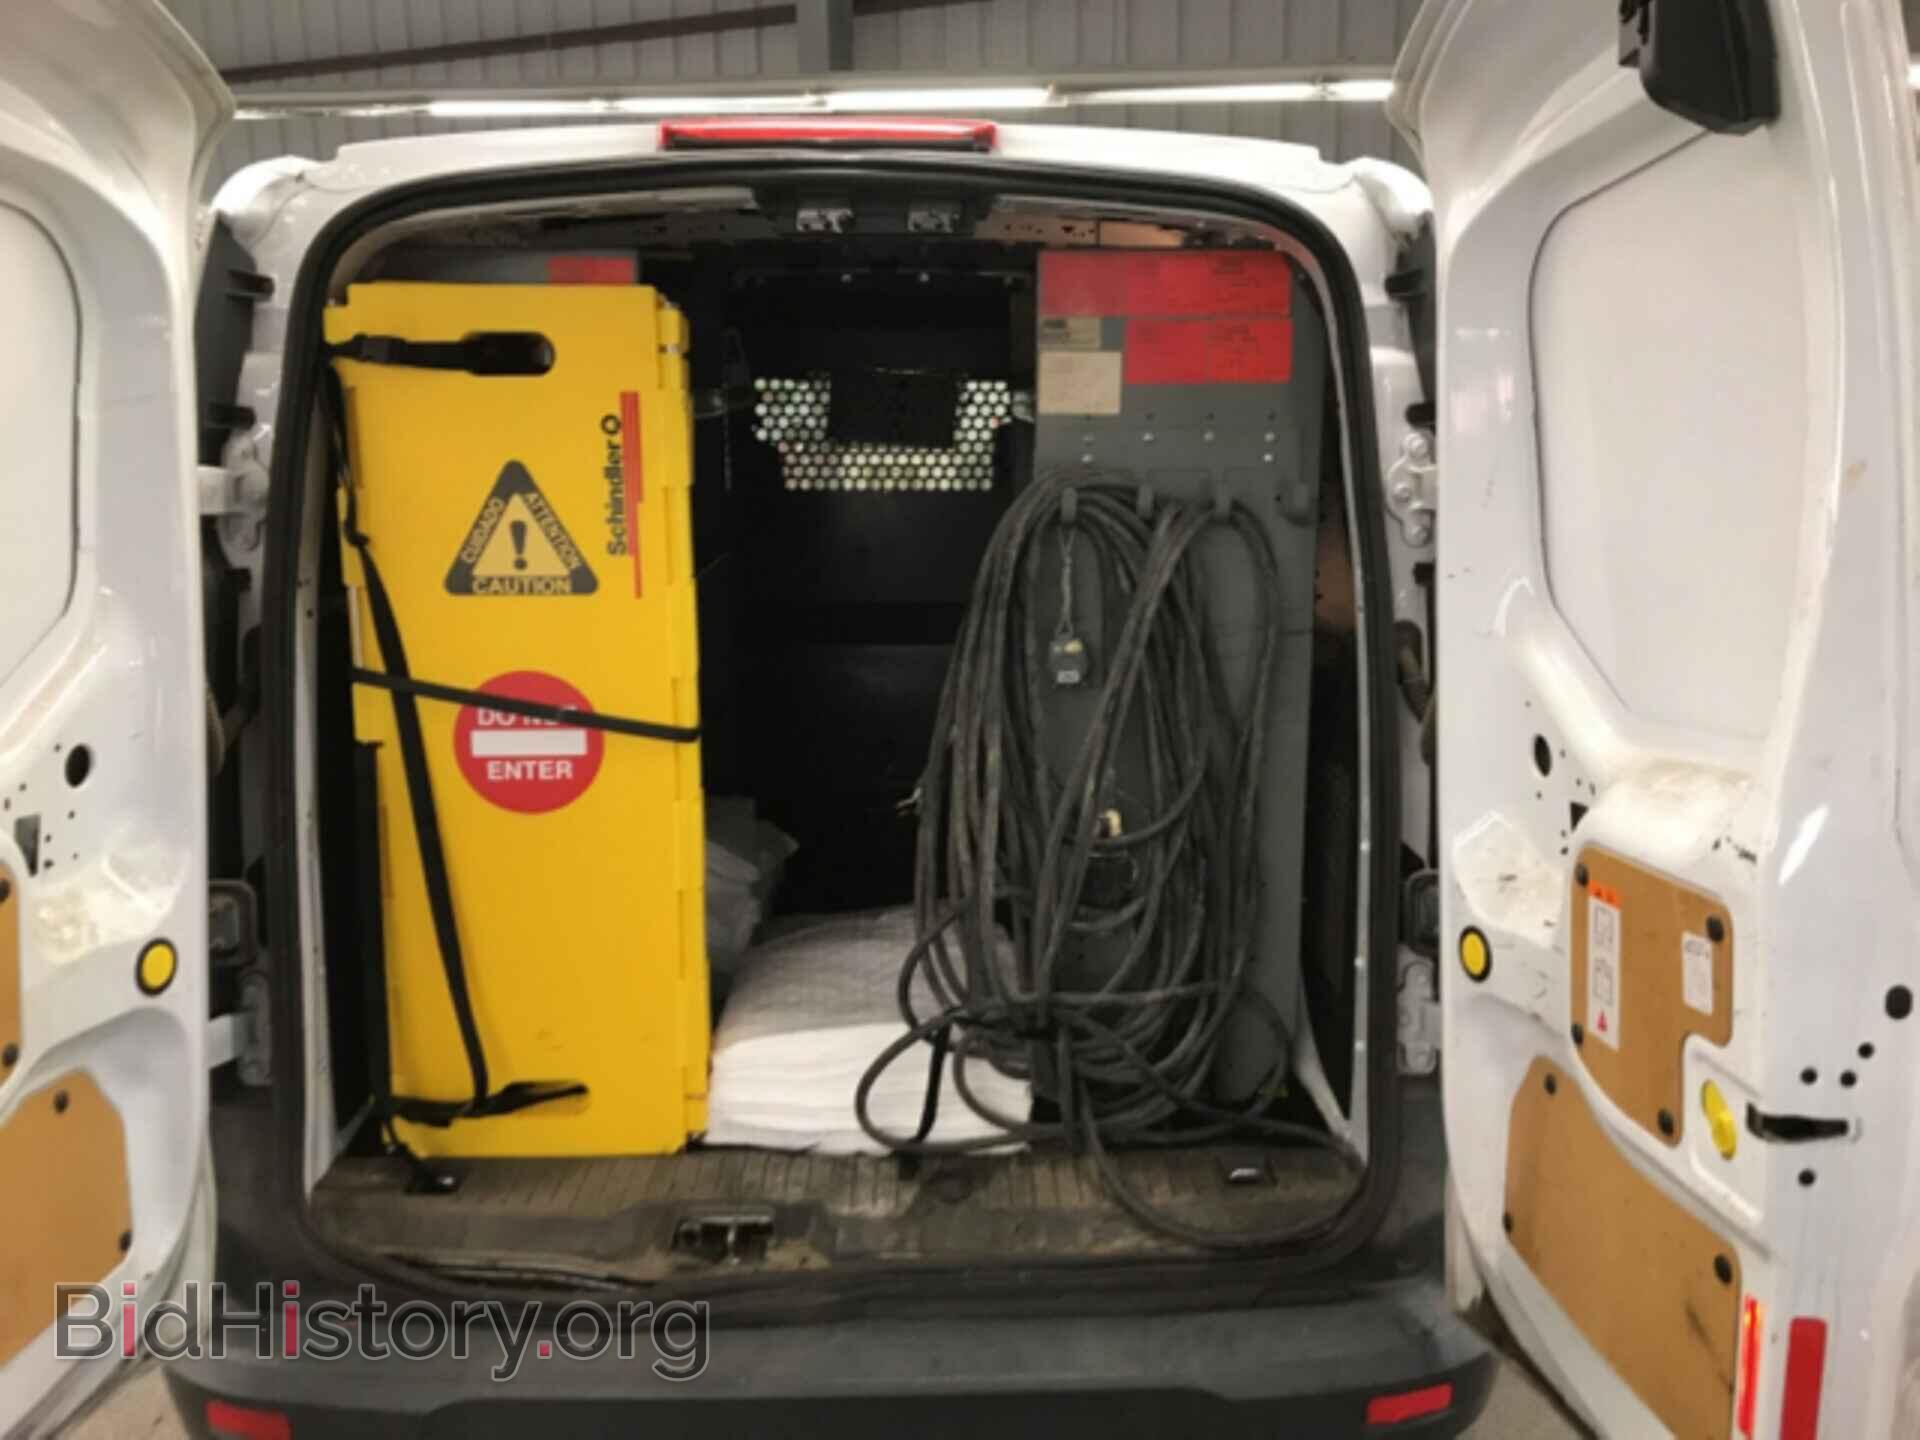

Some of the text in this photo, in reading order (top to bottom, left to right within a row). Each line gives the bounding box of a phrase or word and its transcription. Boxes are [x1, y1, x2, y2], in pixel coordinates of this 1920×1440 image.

[603, 440, 627, 556] Schindler
[472, 576, 571, 595] CAUTION
[485, 759, 574, 781] ENTER
